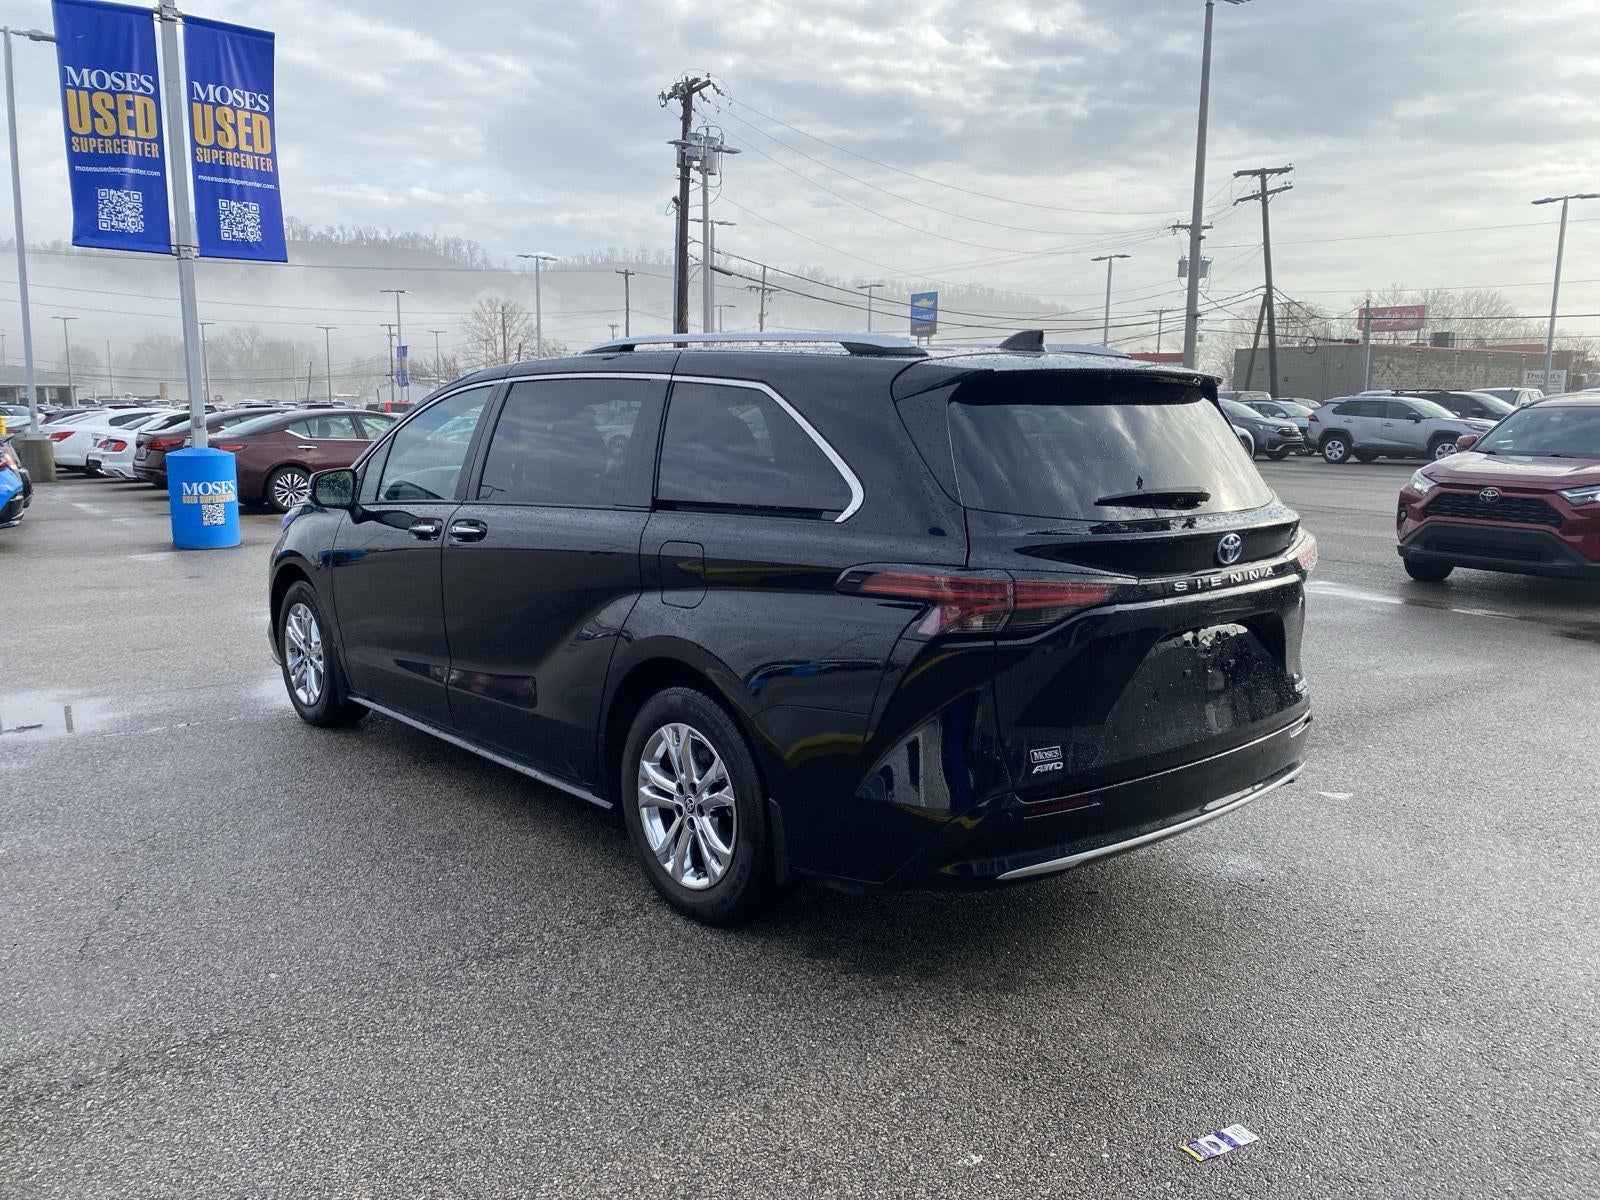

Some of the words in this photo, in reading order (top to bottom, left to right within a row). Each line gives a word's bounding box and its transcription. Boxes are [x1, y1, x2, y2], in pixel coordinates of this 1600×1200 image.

[64, 65, 154, 94] MOSES
[192, 81, 270, 113] MOSES
[66, 89, 158, 139] USED
[192, 102, 272, 155] USED
[72, 136, 160, 158] SUPERCENTER
[75, 165, 161, 176] mosesusedsupercenter.com
[196, 147, 273, 172] SUPERCENTER
[198, 174, 275, 189] mosesusedsupercenter.com
[181, 480, 235, 496] MOSES
[1174, 566, 1275, 592] SIENNA
[1033, 750, 1059, 761] MOSES
[1032, 761, 1064, 774] AWD
